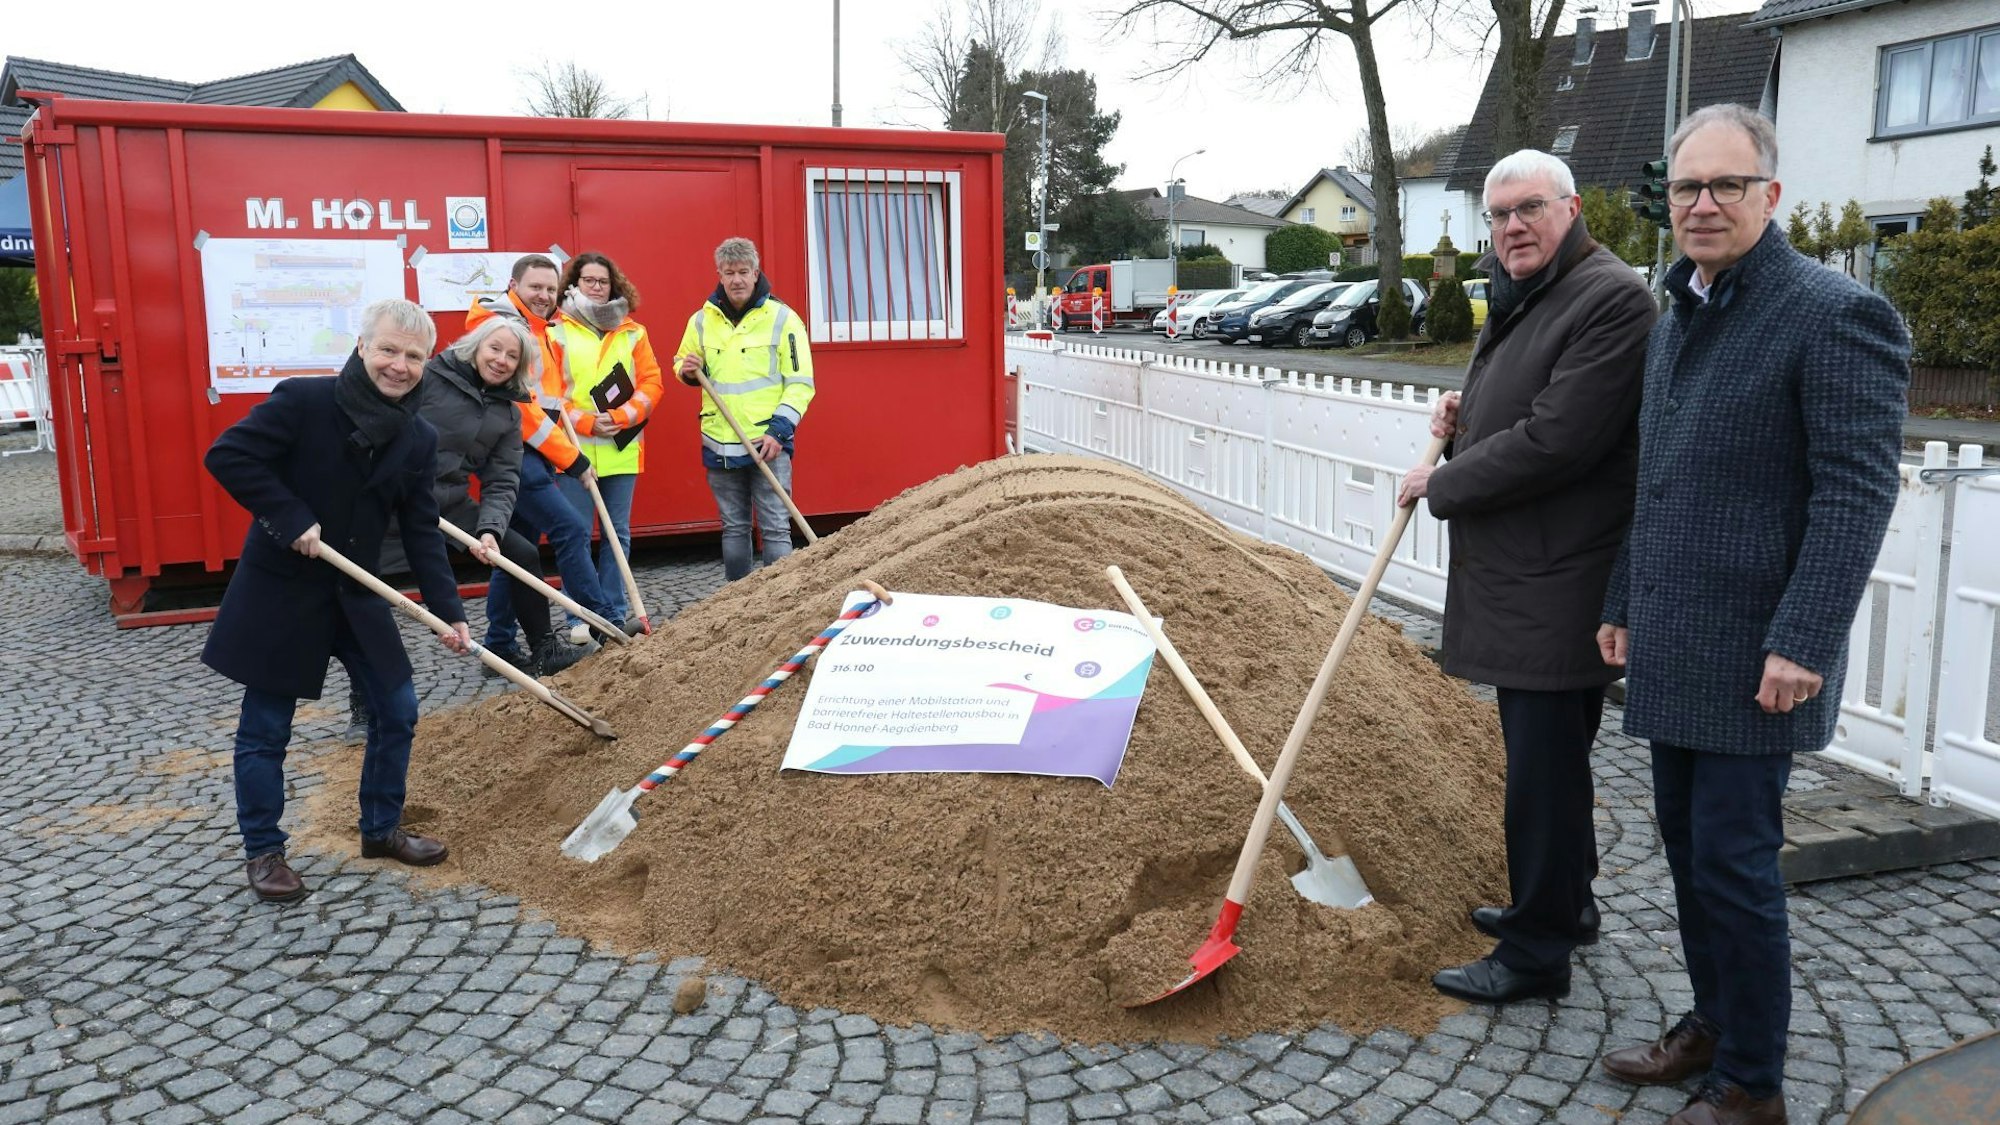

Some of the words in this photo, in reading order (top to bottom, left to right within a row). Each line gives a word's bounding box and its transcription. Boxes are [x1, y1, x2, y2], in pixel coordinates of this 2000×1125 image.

[246, 197, 298, 229] M.
[312, 198, 431, 230] HOLL
[840, 634, 1054, 657] Zuwendungsbescheid
[831, 663, 875, 673] 316.100
[1024, 673, 1033, 681] €
[818, 695, 875, 707] Errichtung
[877, 697, 906, 706] einer
[908, 696, 983, 706] Mobilstation
[985, 699, 1010, 707] und
[812, 707, 888, 720] barrierefreier
[891, 709, 1005, 720] Haltestellenausbau
[1007, 711, 1020, 720] in
[807, 720, 832, 730] Bad
[833, 722, 959, 735] Honnef-Aegidienberg
